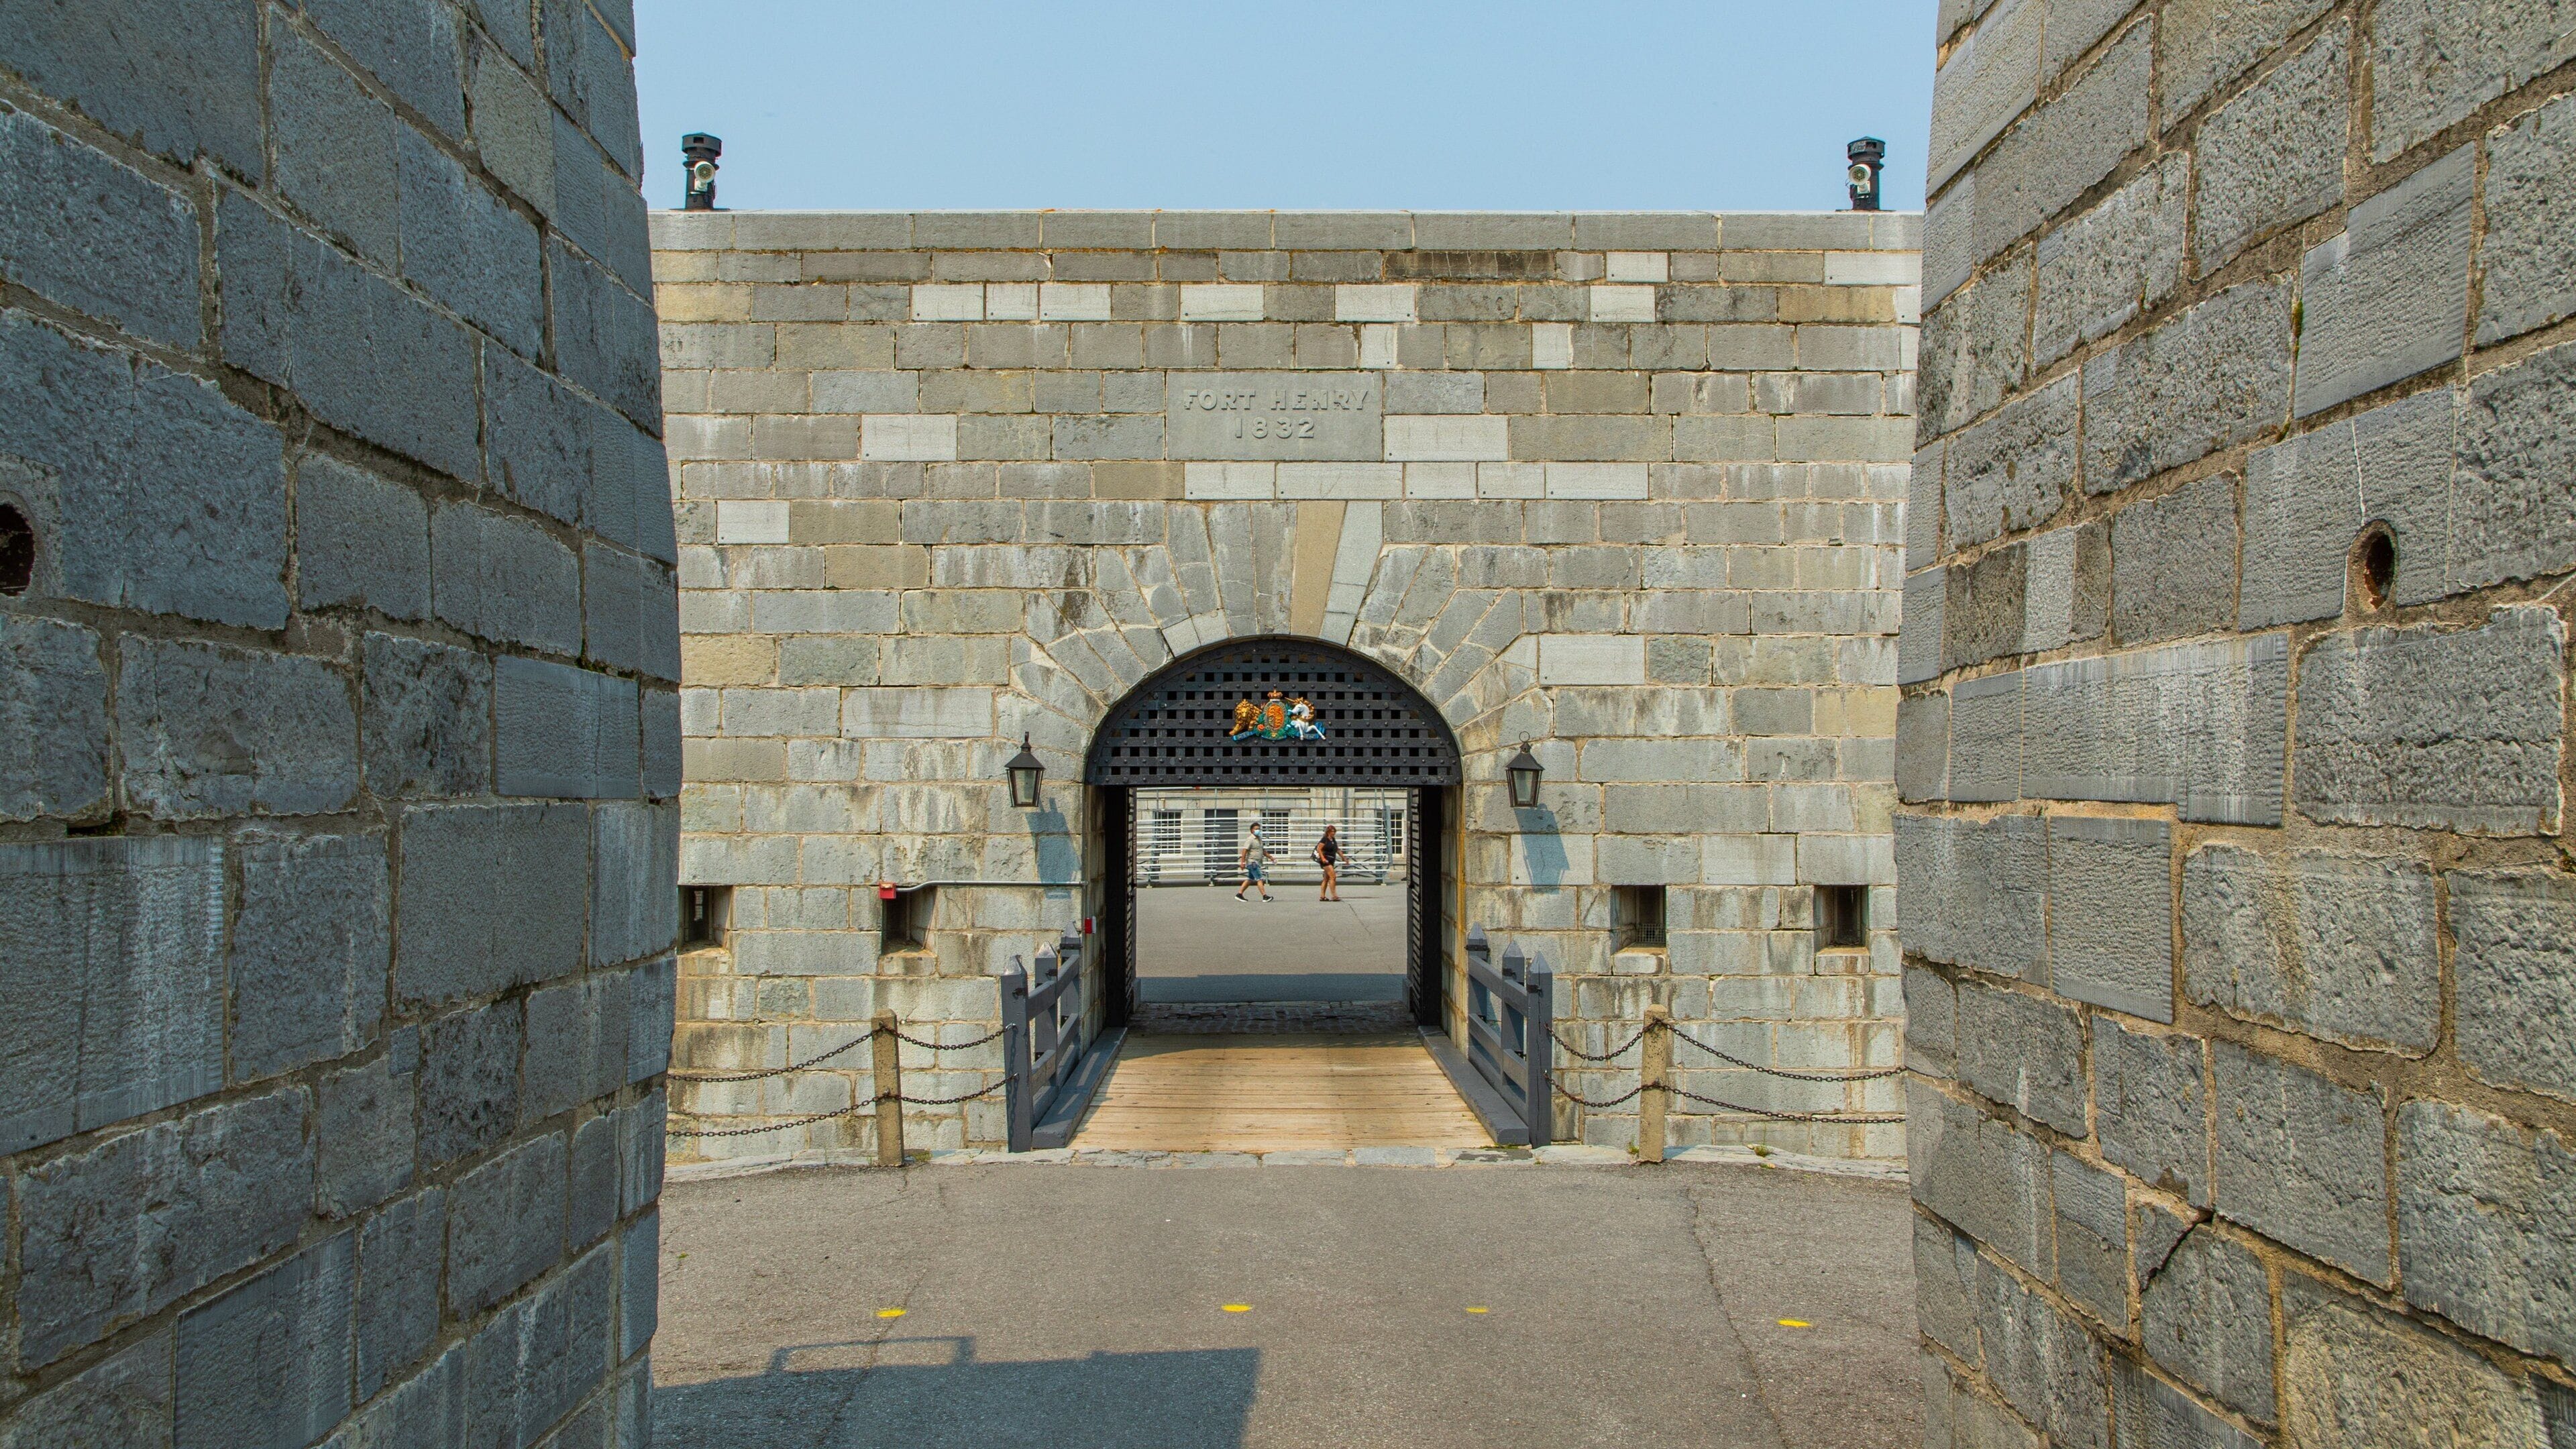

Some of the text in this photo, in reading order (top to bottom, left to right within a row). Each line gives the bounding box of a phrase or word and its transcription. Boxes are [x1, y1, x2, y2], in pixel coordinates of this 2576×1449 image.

[1185, 390, 1368, 411] FORT HENRY
[1235, 417, 1315, 439] 1832
